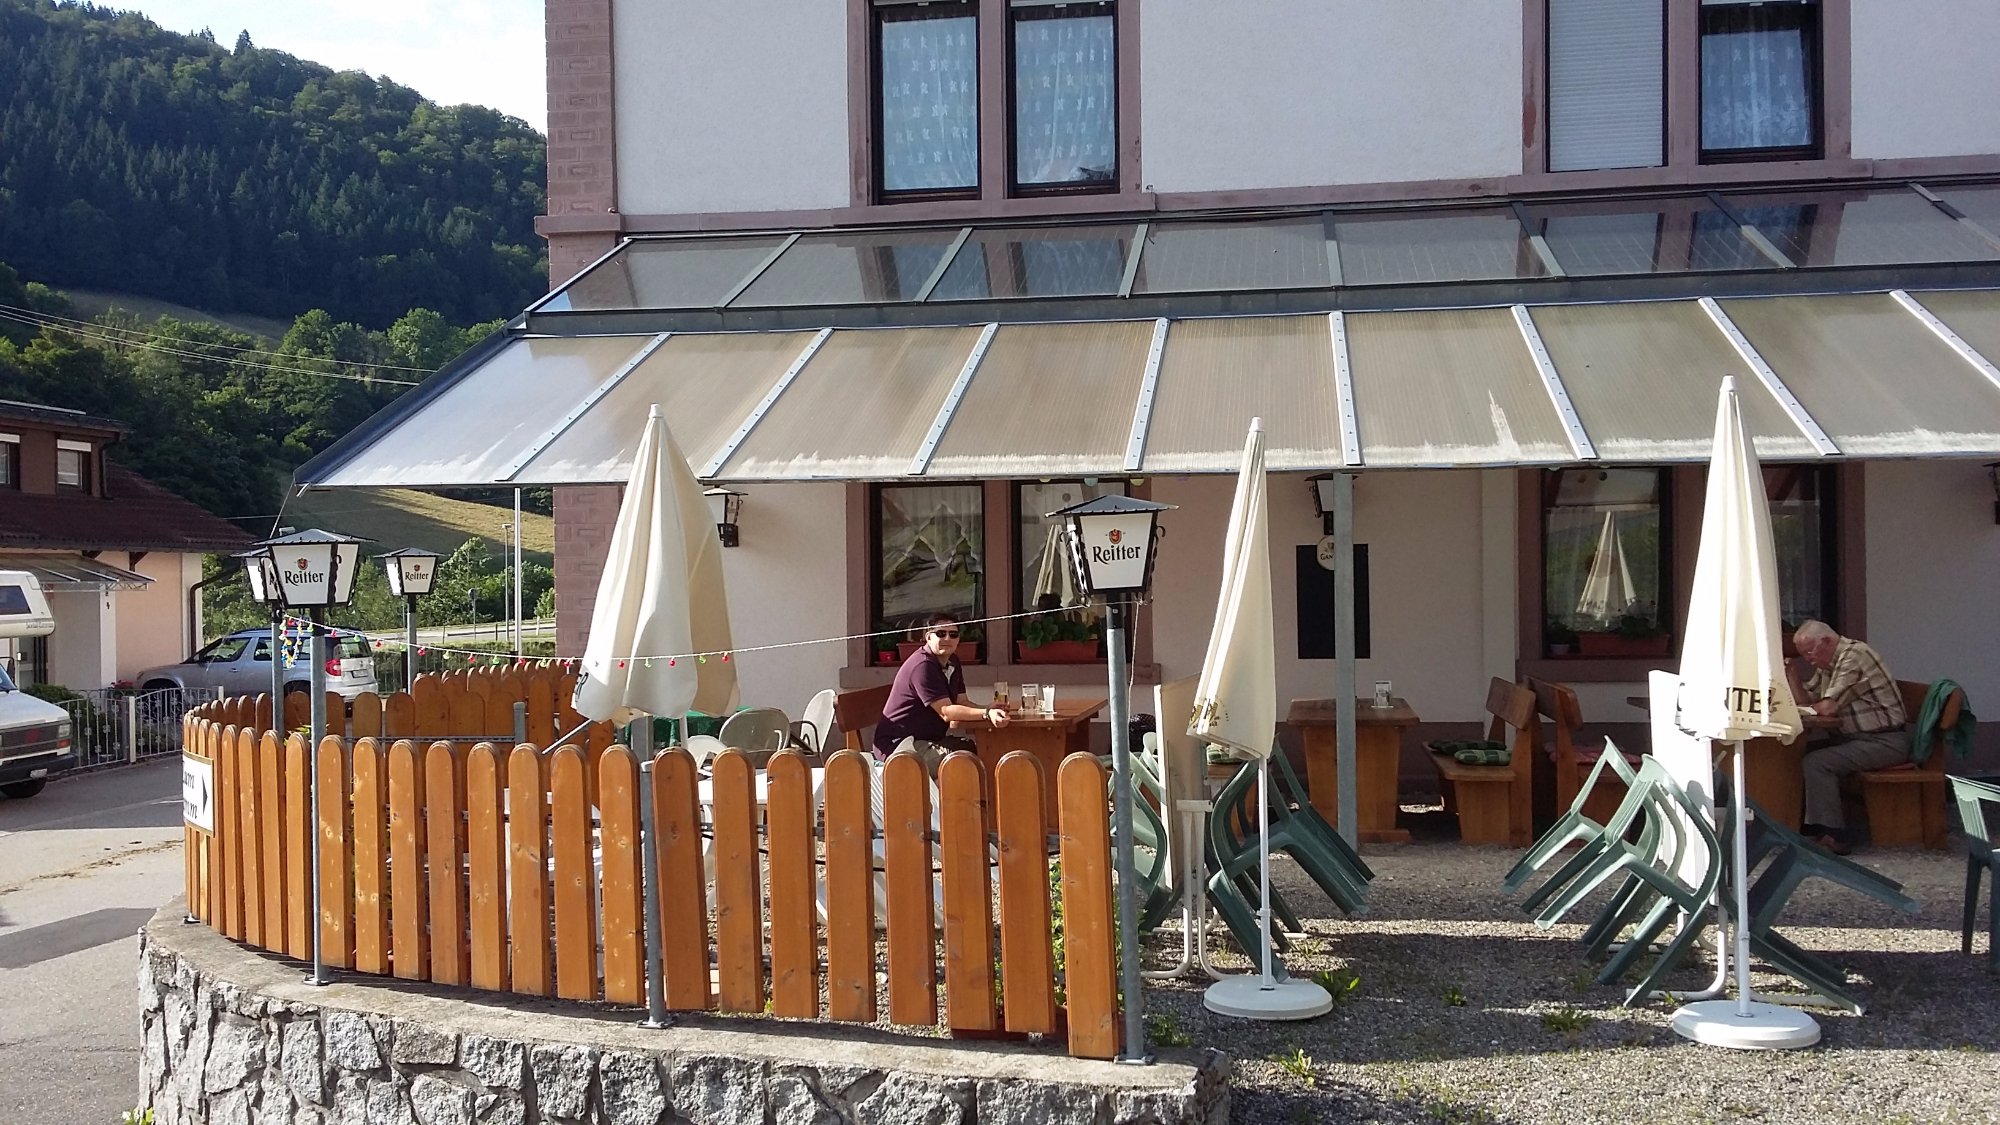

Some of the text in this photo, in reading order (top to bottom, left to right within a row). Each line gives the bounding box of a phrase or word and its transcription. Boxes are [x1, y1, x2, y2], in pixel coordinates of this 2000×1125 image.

[1092, 545, 1141, 565] Reitter
[284, 570, 324, 587] Reitter
[404, 571, 429, 581] Reitter
